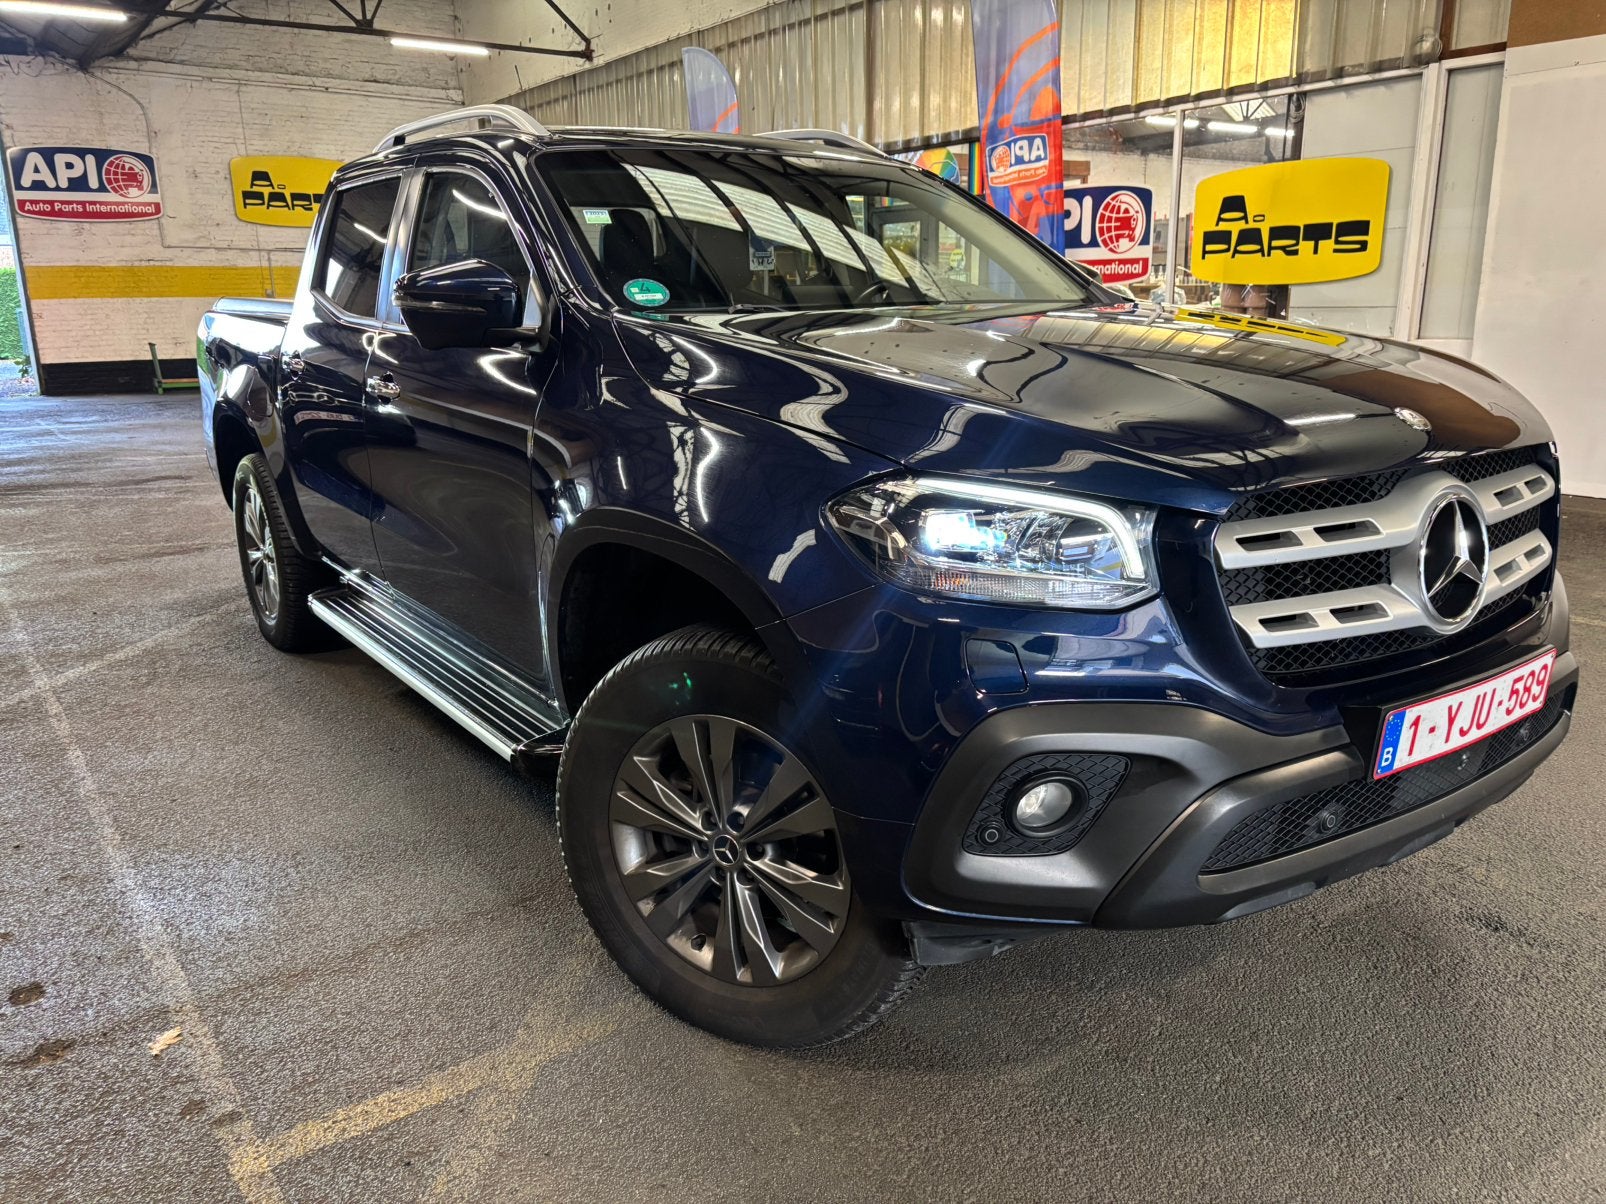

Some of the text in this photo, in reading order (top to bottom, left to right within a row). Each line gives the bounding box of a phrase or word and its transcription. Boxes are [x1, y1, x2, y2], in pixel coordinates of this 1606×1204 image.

[20, 151, 100, 190] API
[24, 202, 156, 213] Auto Parts International
[1202, 220, 1371, 260] PARTS
[1381, 746, 1394, 767] B
